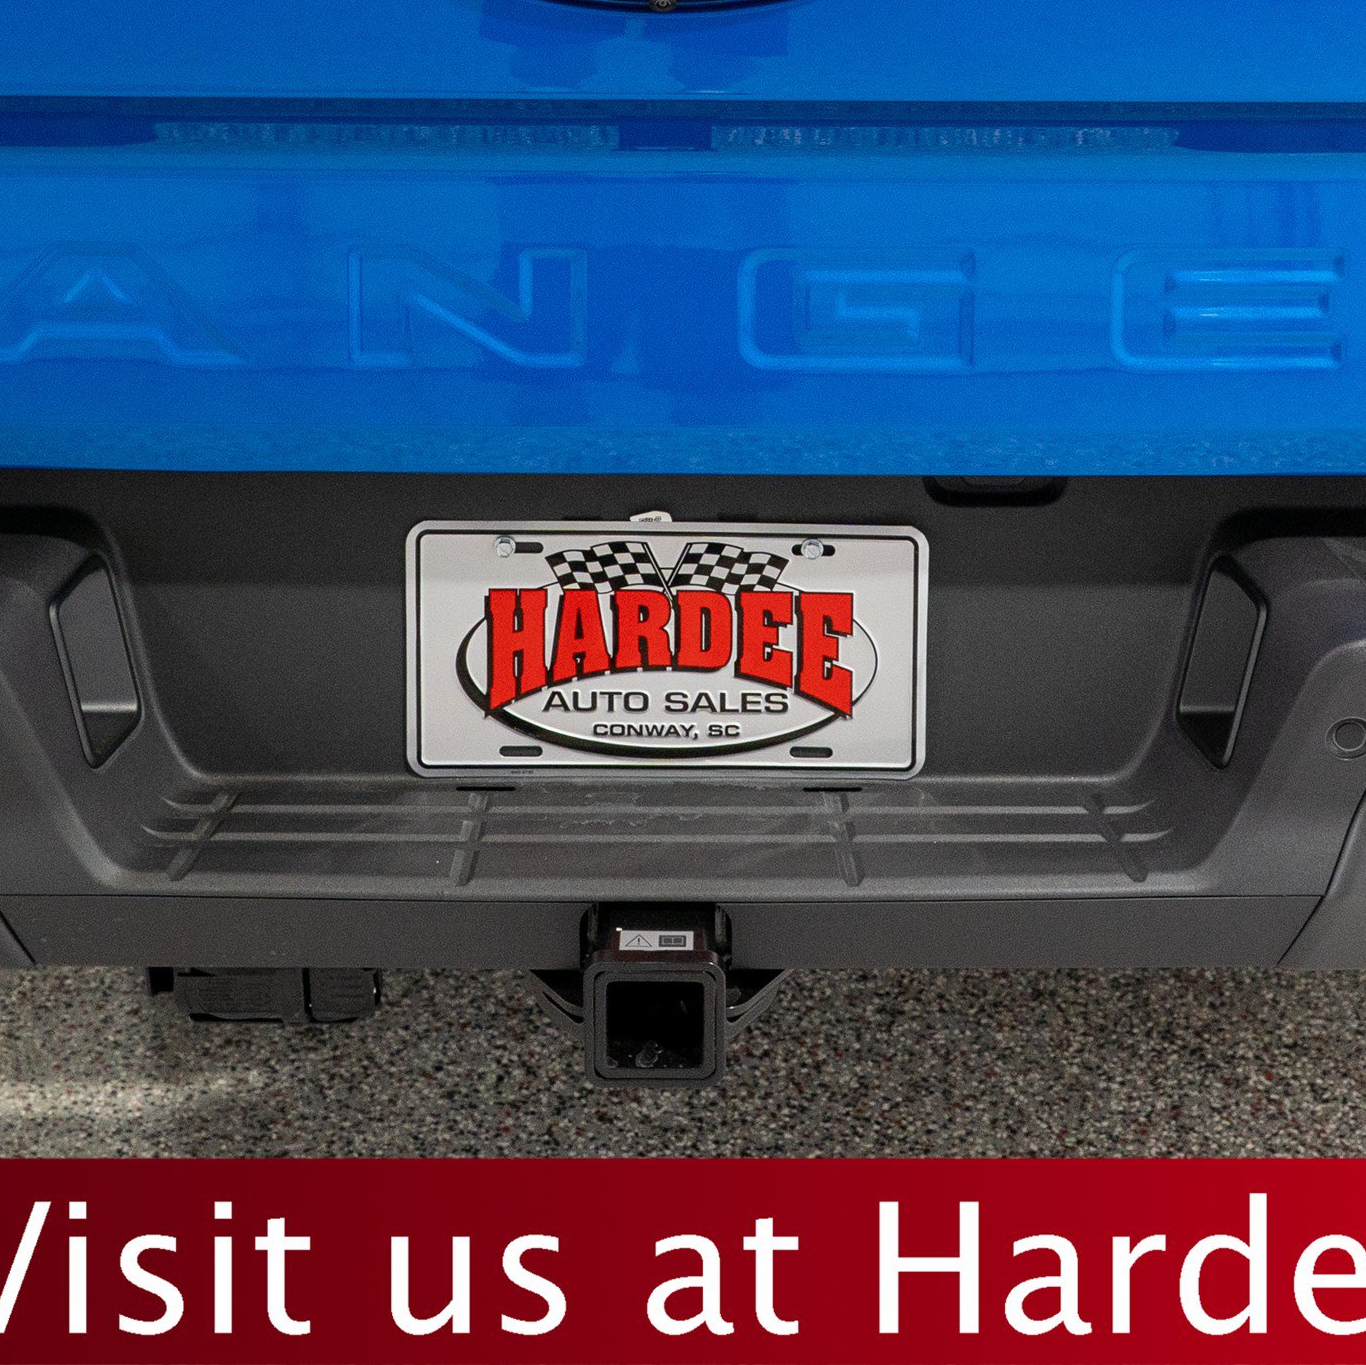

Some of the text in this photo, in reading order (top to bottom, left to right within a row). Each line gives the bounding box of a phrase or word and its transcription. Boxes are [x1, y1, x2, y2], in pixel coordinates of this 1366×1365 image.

[485, 588, 853, 718] HARDEE
[543, 691, 789, 713] AUTO SALES
[593, 724, 740, 740] CONWAY, SC
